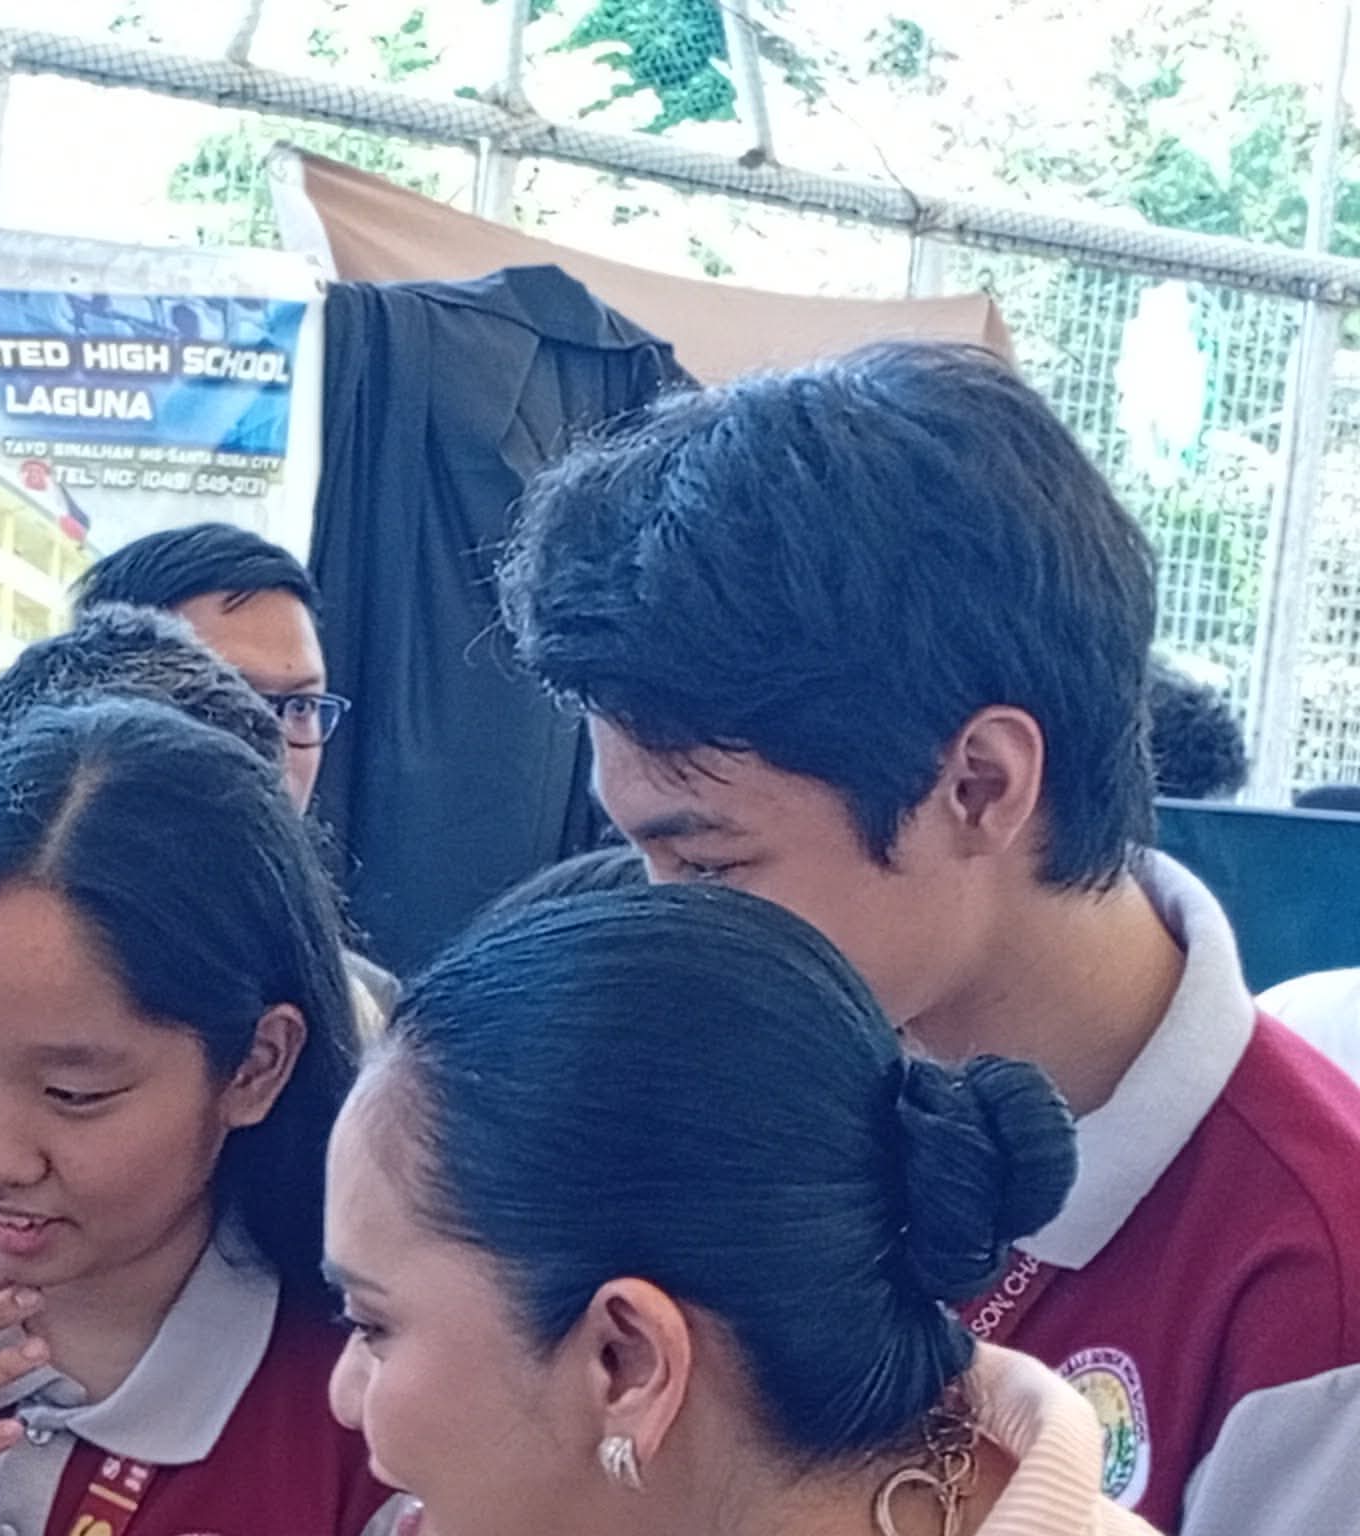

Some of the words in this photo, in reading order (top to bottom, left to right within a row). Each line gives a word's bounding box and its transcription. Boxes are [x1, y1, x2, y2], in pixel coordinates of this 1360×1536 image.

[83, 342, 170, 373] HIGH
[182, 345, 291, 384] SCHOOL
[6, 385, 153, 420] LAGUNA
[4, 440, 47, 456] TAYO
